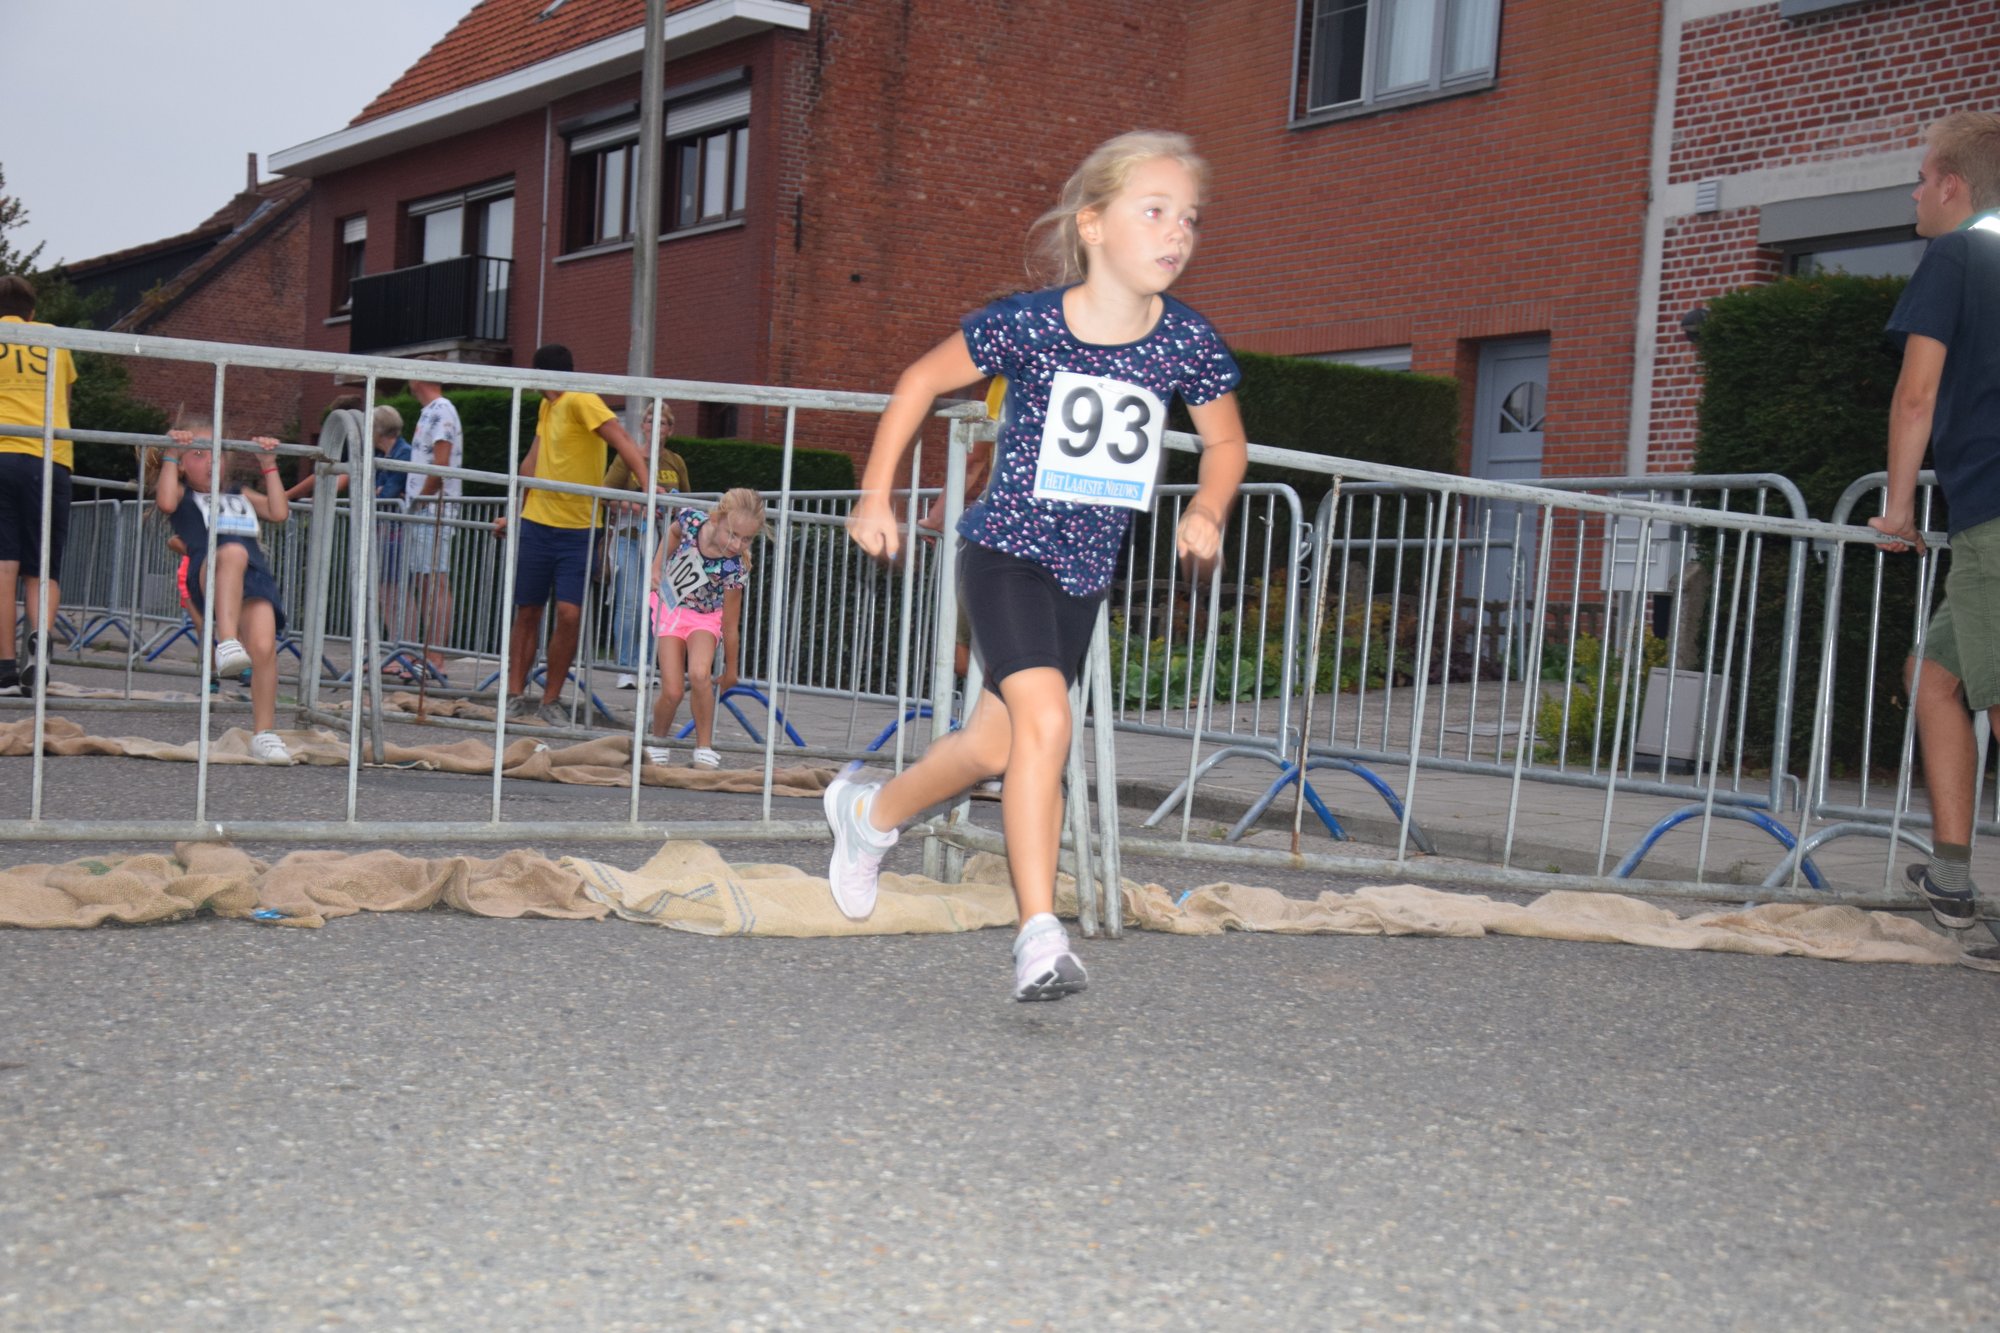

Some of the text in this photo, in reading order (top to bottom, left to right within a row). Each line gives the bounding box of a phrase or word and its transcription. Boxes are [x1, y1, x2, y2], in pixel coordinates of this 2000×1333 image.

[1057, 385, 1151, 465] 93
[1044, 471, 1140, 498] HET LAATSTE NIEUWS
[669, 554, 700, 597] 102
